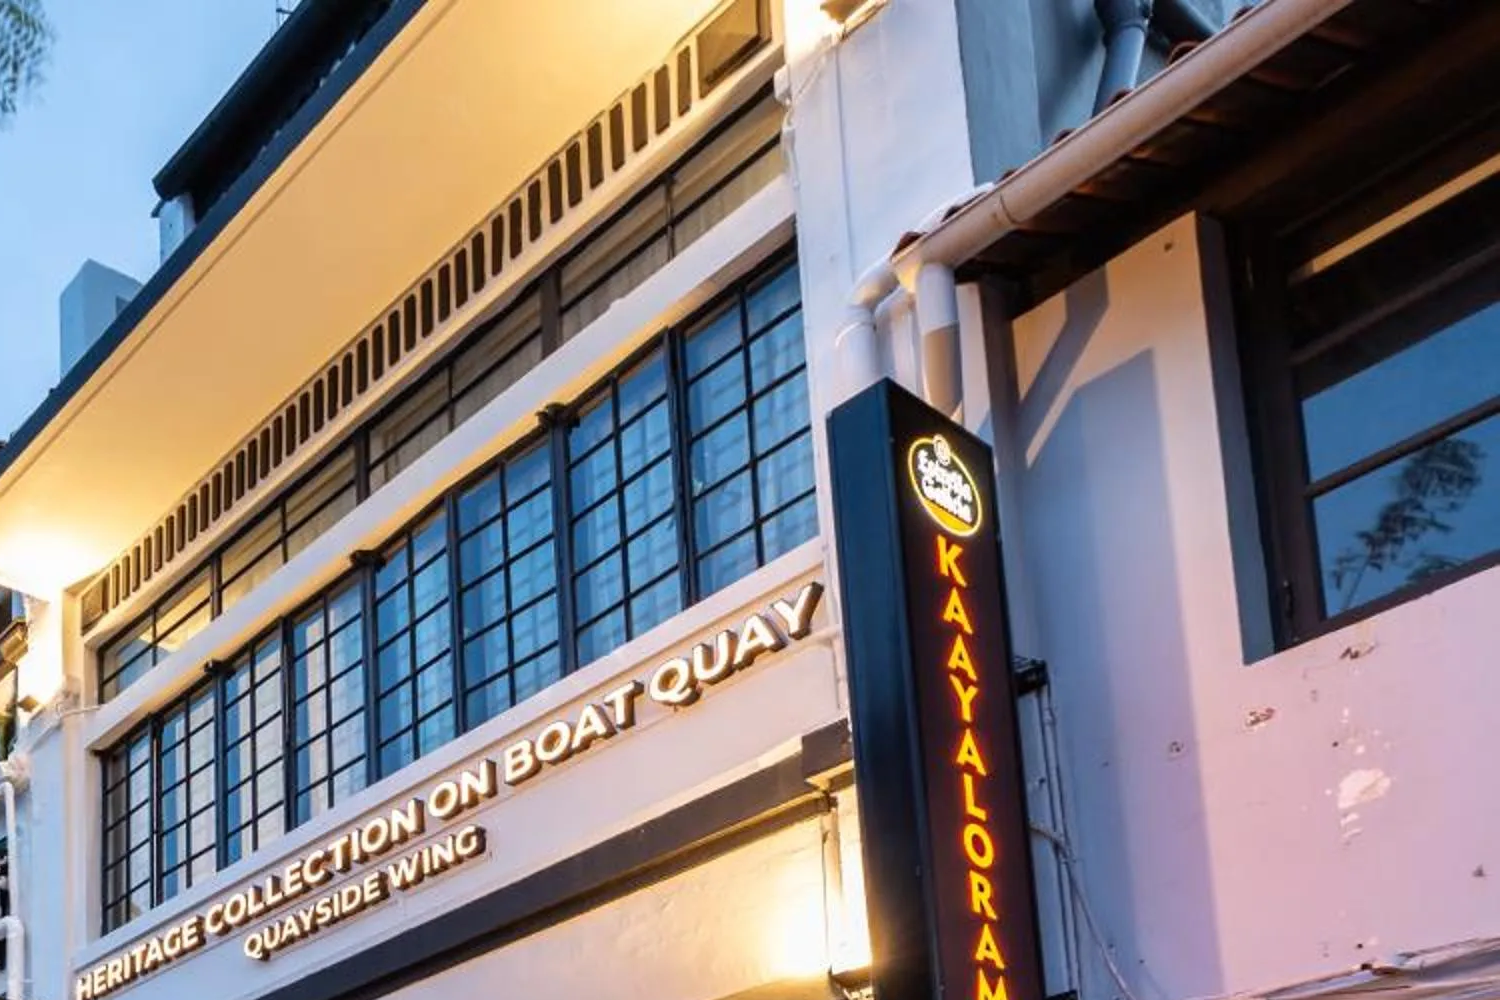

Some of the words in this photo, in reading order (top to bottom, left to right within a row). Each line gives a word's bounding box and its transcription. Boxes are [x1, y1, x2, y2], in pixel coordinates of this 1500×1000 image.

[204, 801, 424, 935] COLLECTION
[427, 759, 495, 820] ON
[504, 680, 642, 785] BOAT
[649, 581, 823, 705] QUAY
[243, 869, 388, 961] QUAYSIDE
[388, 824, 486, 892] WING
